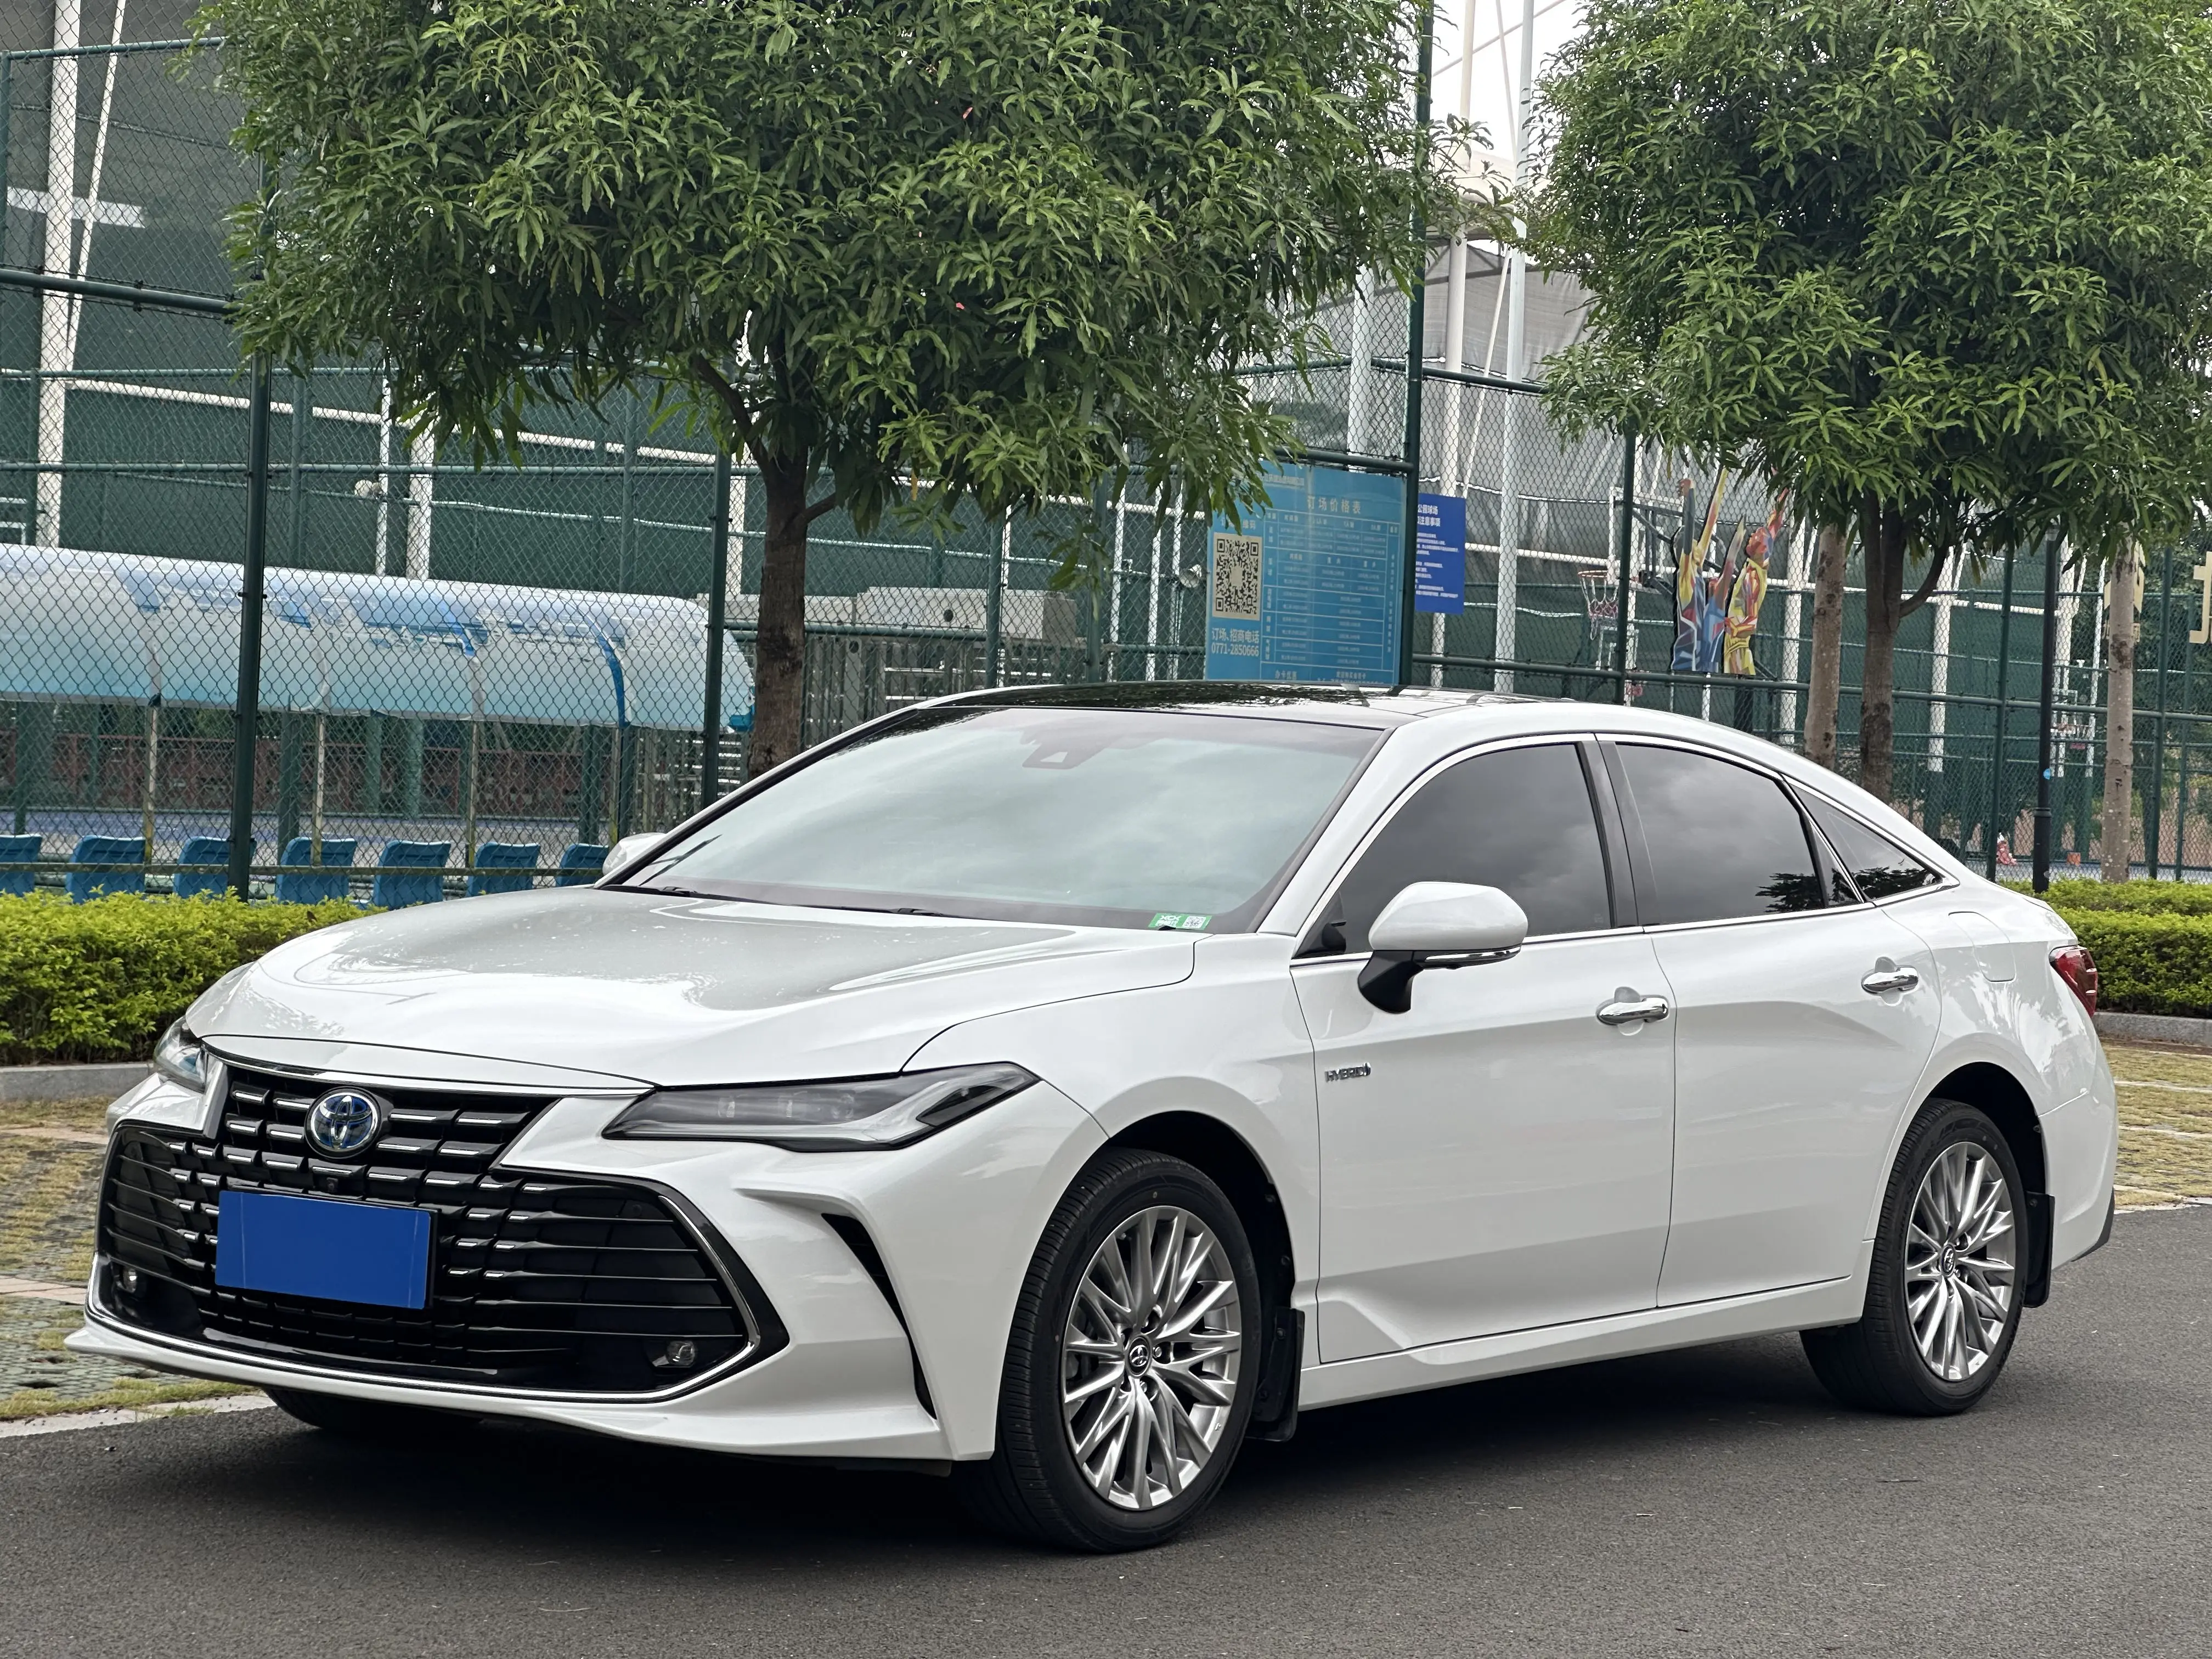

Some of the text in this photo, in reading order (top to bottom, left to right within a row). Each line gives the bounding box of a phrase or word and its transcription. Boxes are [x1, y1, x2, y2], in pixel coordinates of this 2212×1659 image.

[1307, 495, 1361, 514] 订场价格表
[1211, 628, 1260, 644] 订场、招商电话
[1211, 642, 1259, 657] 0771-2850666
